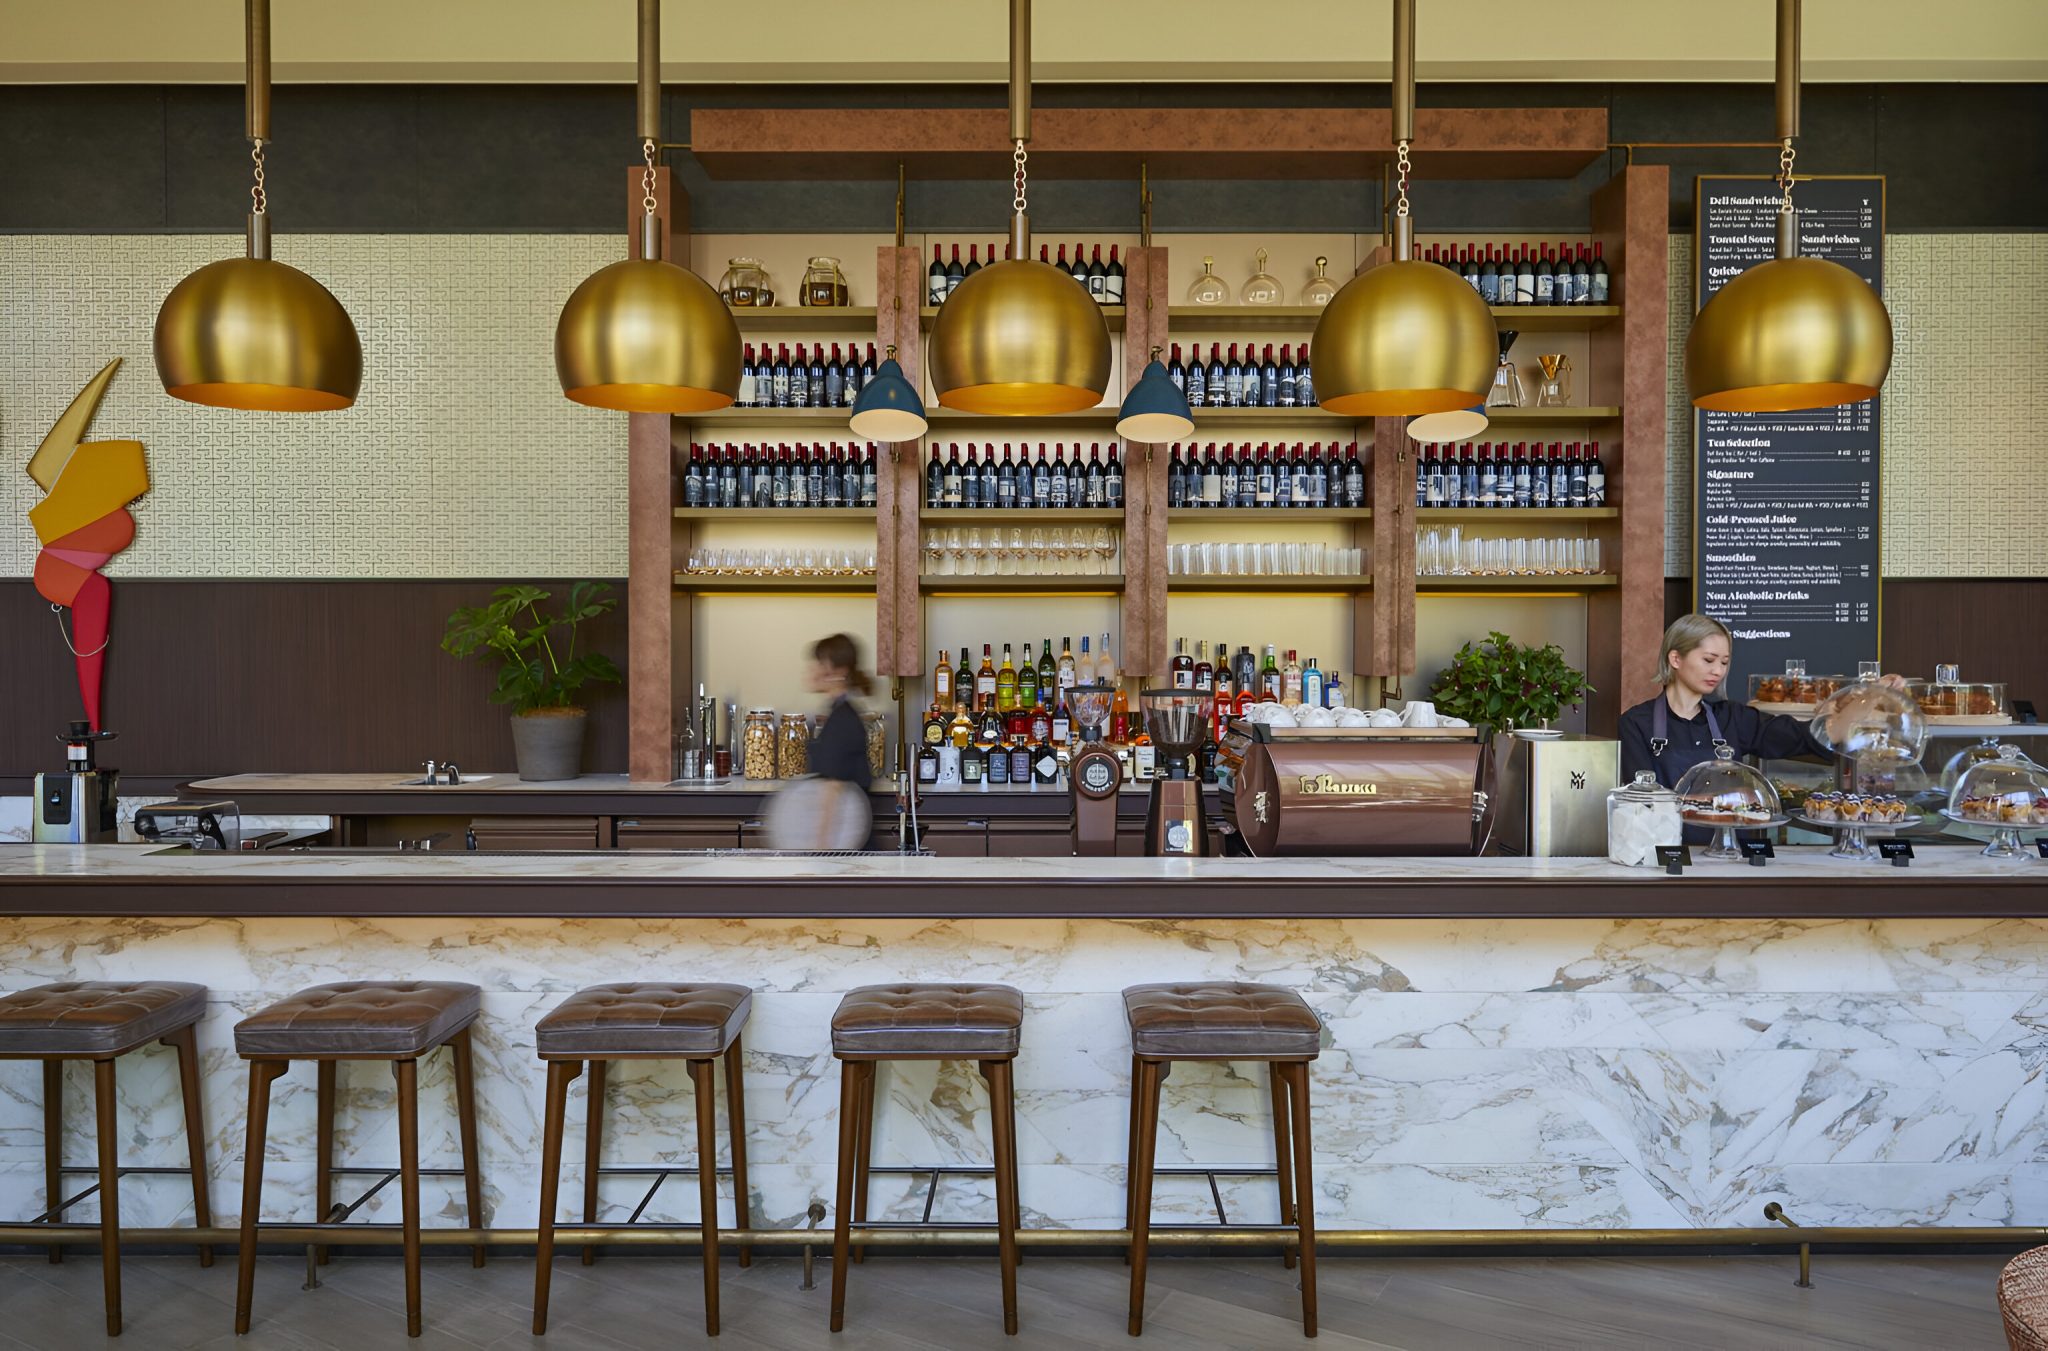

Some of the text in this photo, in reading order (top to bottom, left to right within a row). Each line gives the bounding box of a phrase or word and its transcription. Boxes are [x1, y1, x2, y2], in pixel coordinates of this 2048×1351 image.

[1710, 196, 1787, 205] Deli Sandwiche
[1709, 234, 1747, 244] Toasted
[1801, 234, 1860, 244] Sandwiches
[1709, 266, 1744, 277] Quiche
[1707, 437, 1771, 447] Tea Selection
[1706, 469, 1754, 480] Signature
[1706, 515, 1728, 524] Cold
[1770, 515, 1797, 524] Juice
[1706, 553, 1756, 562] Smoothies
[1706, 591, 1809, 600] Non Alcoholic Drinks
[1733, 629, 1791, 639] Suggestions
